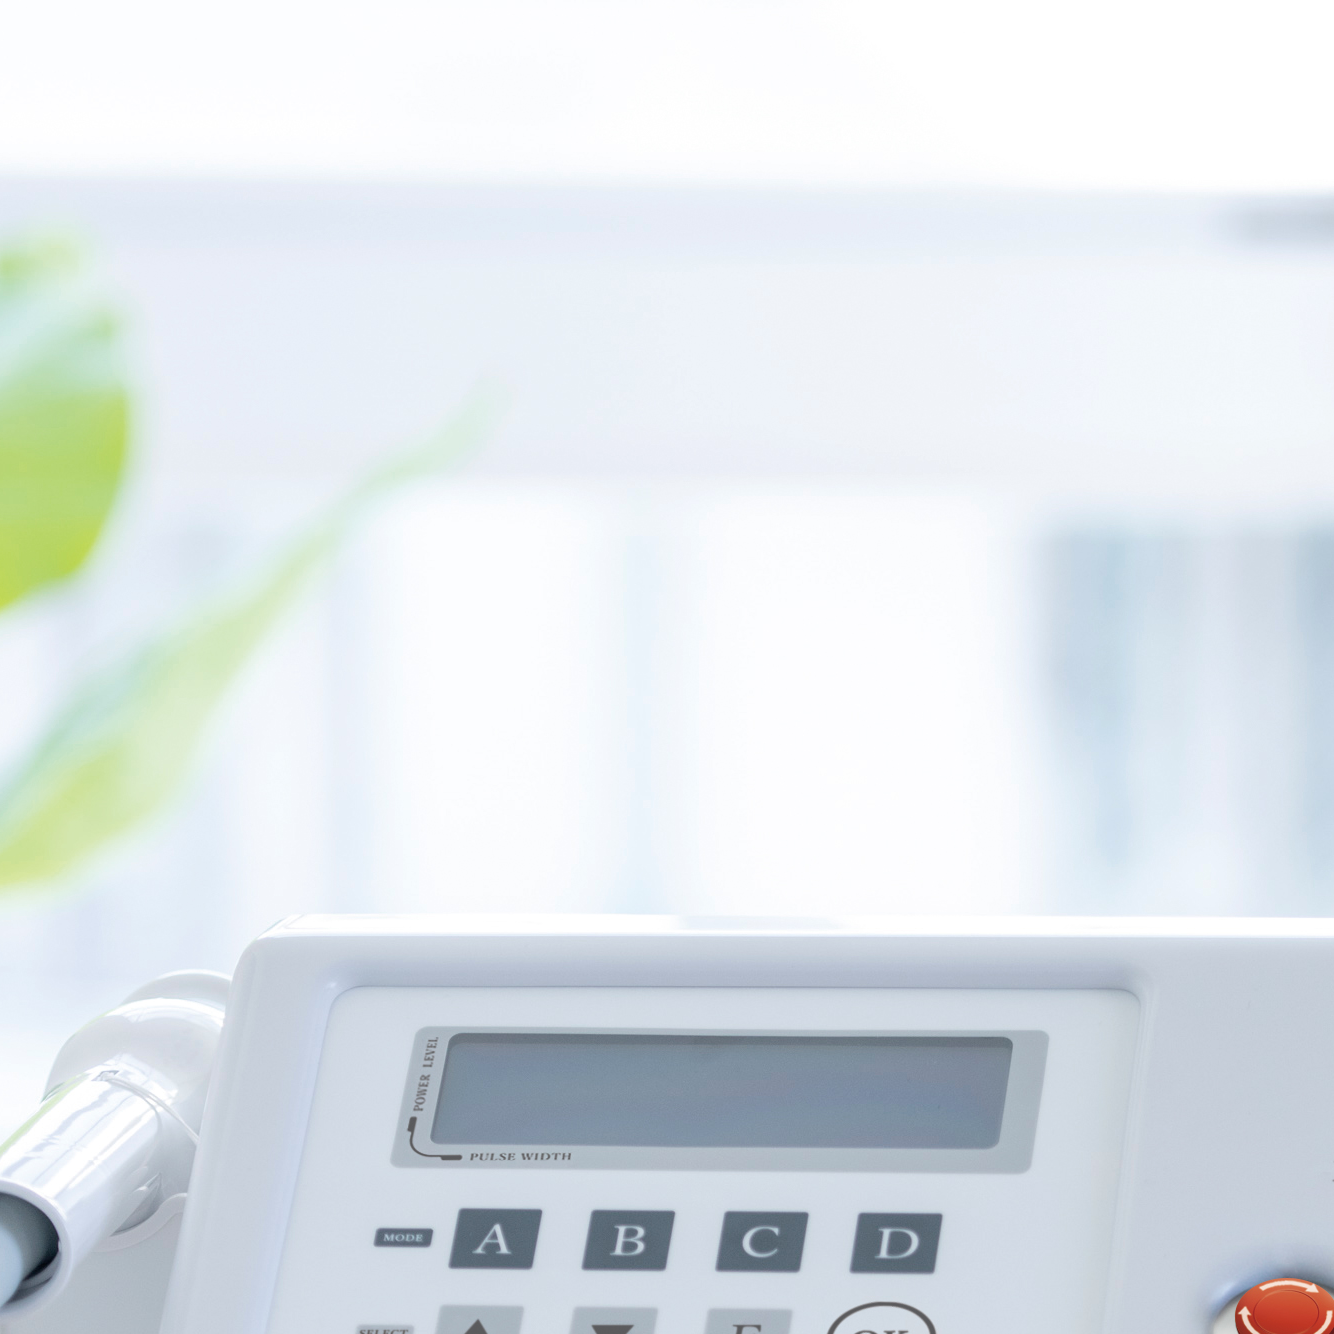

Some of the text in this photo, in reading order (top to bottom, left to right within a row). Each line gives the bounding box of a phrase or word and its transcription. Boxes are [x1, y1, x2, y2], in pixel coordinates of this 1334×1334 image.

[413, 1037, 439, 1112] POWER LEVEL
[469, 1152, 572, 1161] PULSE WIDTH
[383, 1223, 919, 1259] MODE A B C D
